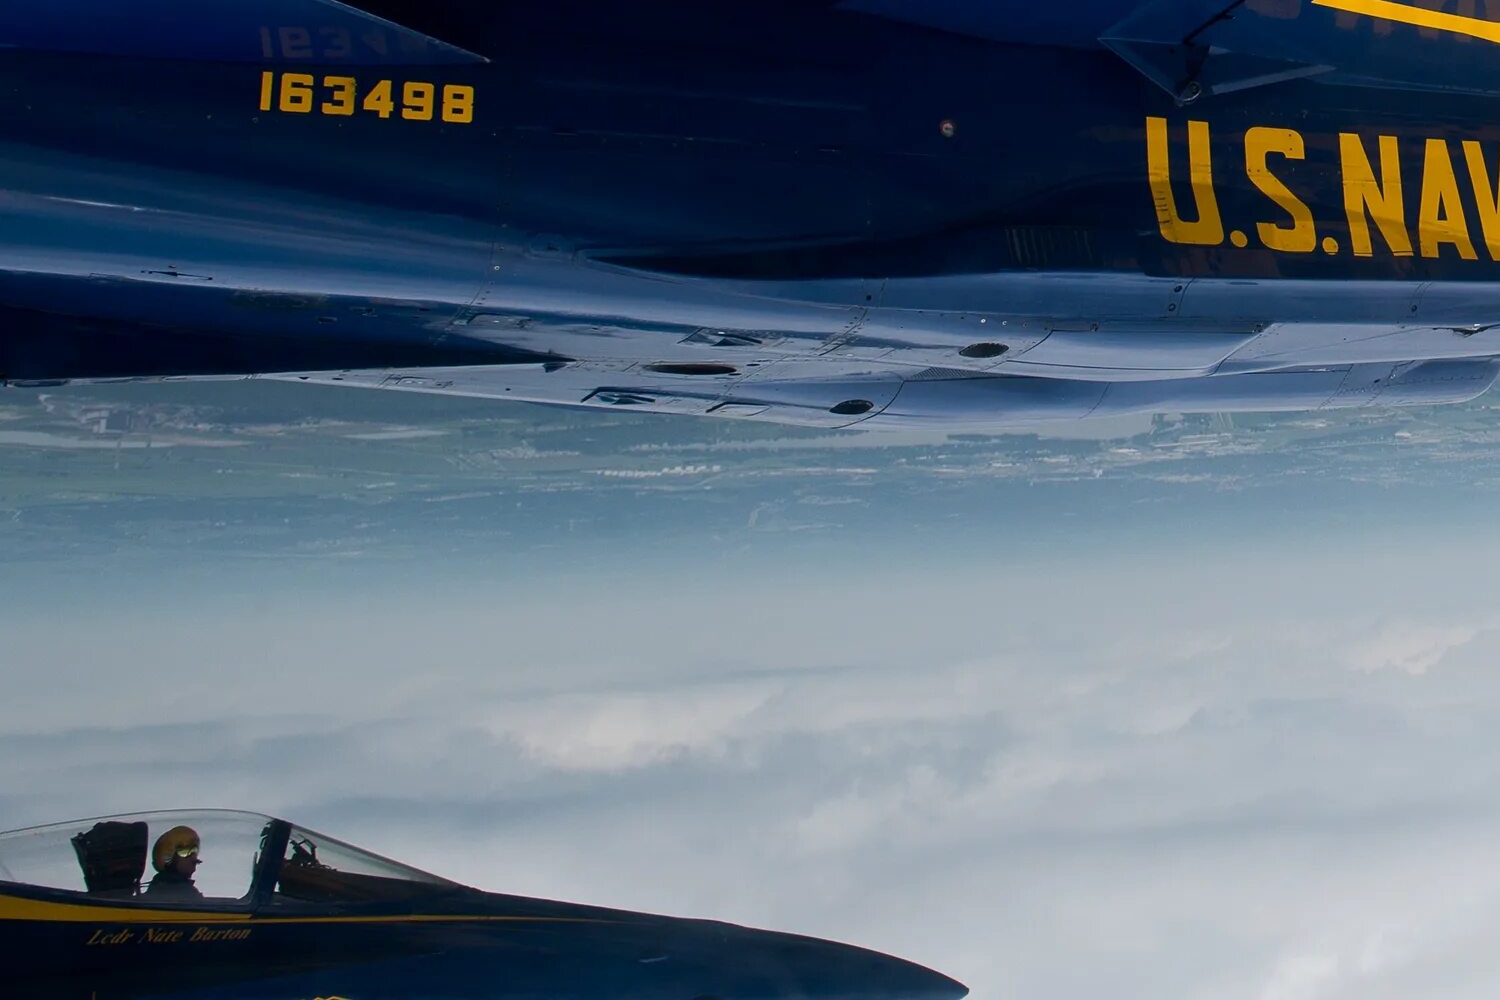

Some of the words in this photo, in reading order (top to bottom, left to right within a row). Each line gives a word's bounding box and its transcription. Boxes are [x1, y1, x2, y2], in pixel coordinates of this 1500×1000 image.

[259, 71, 474, 123] 163498
[86, 928, 135, 946] Lcdr
[136, 927, 184, 944] Nate
[188, 926, 252, 942] Barton
